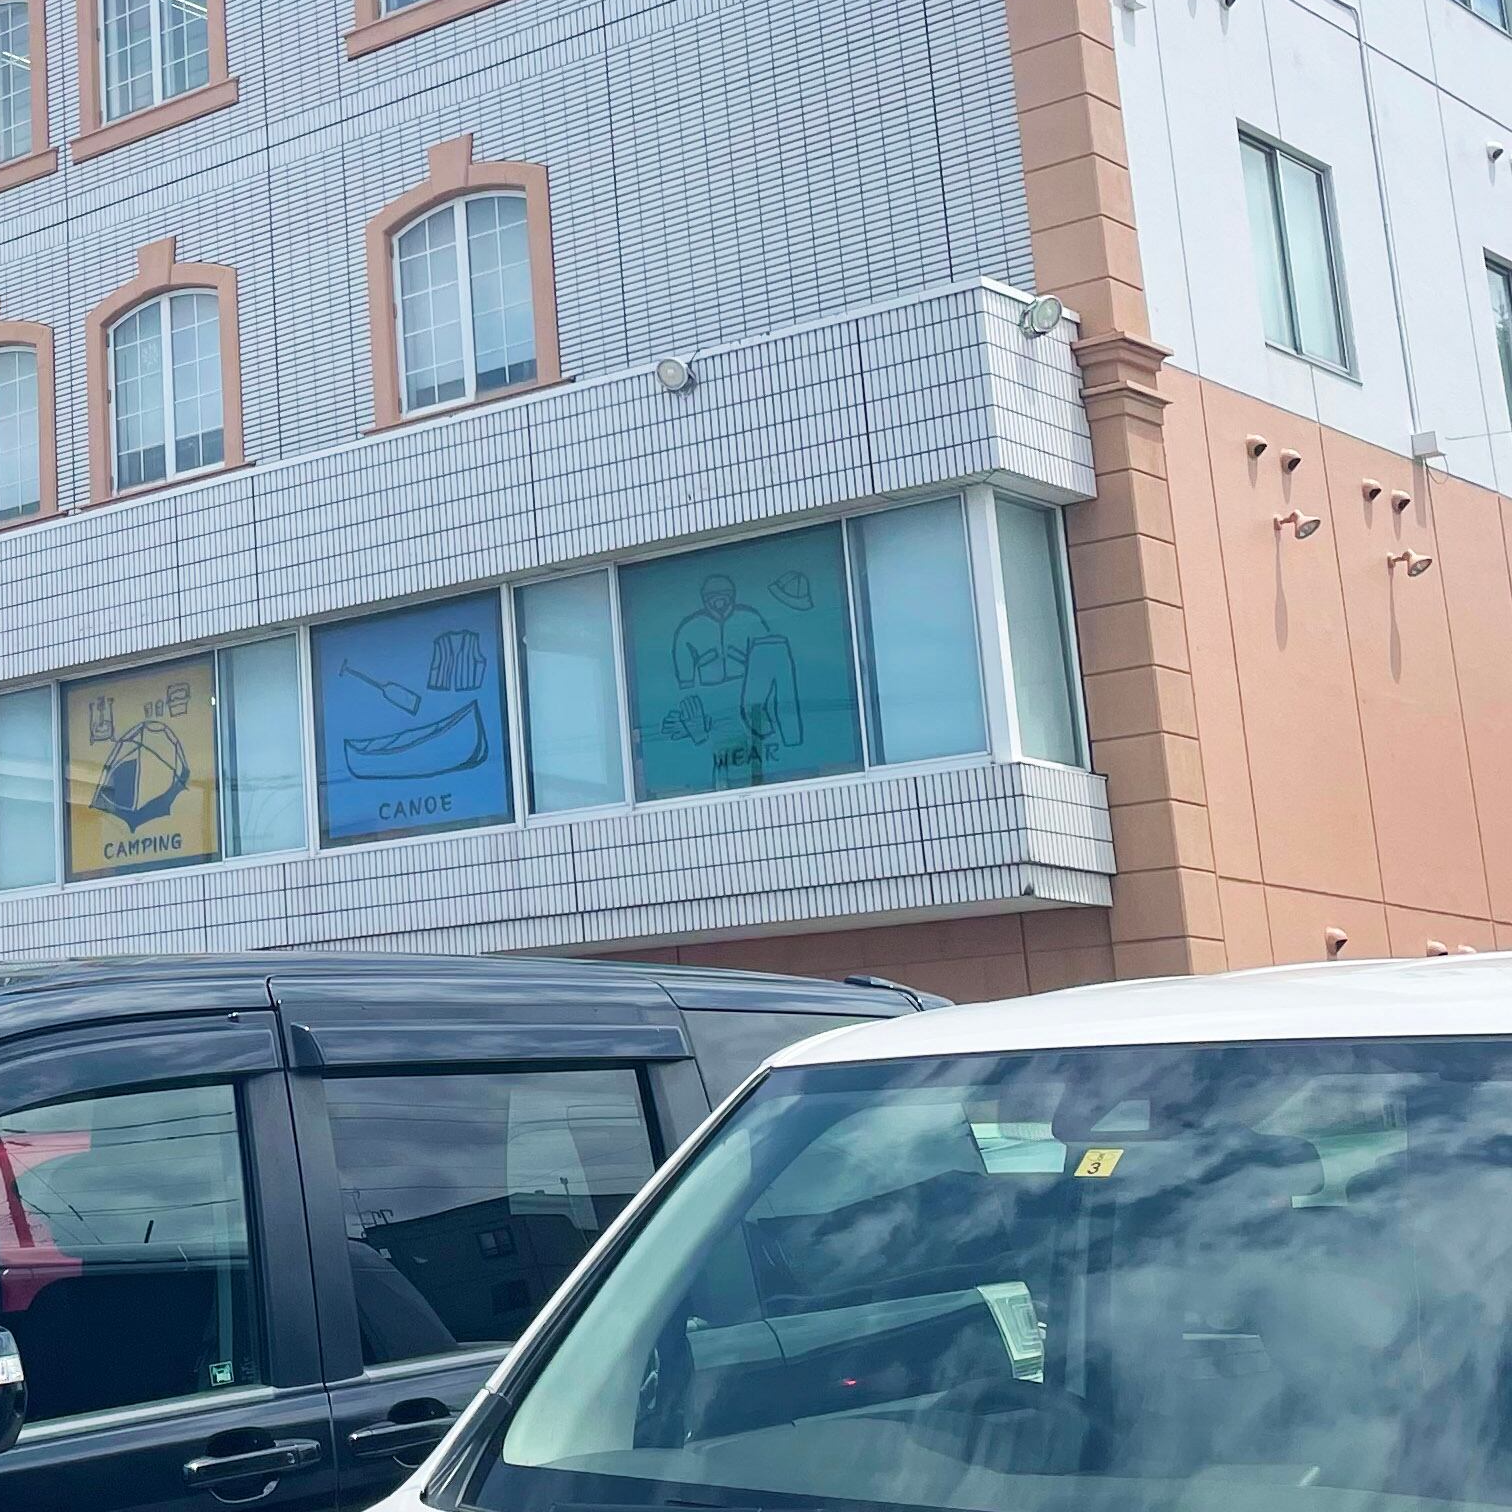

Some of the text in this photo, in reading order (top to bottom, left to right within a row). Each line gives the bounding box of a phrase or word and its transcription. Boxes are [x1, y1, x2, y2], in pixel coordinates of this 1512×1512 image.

[713, 742, 780, 768] WEAR
[379, 793, 452, 820] CANOE
[104, 833, 182, 859] CAMPING
[1087, 1161, 1101, 1175] 3
